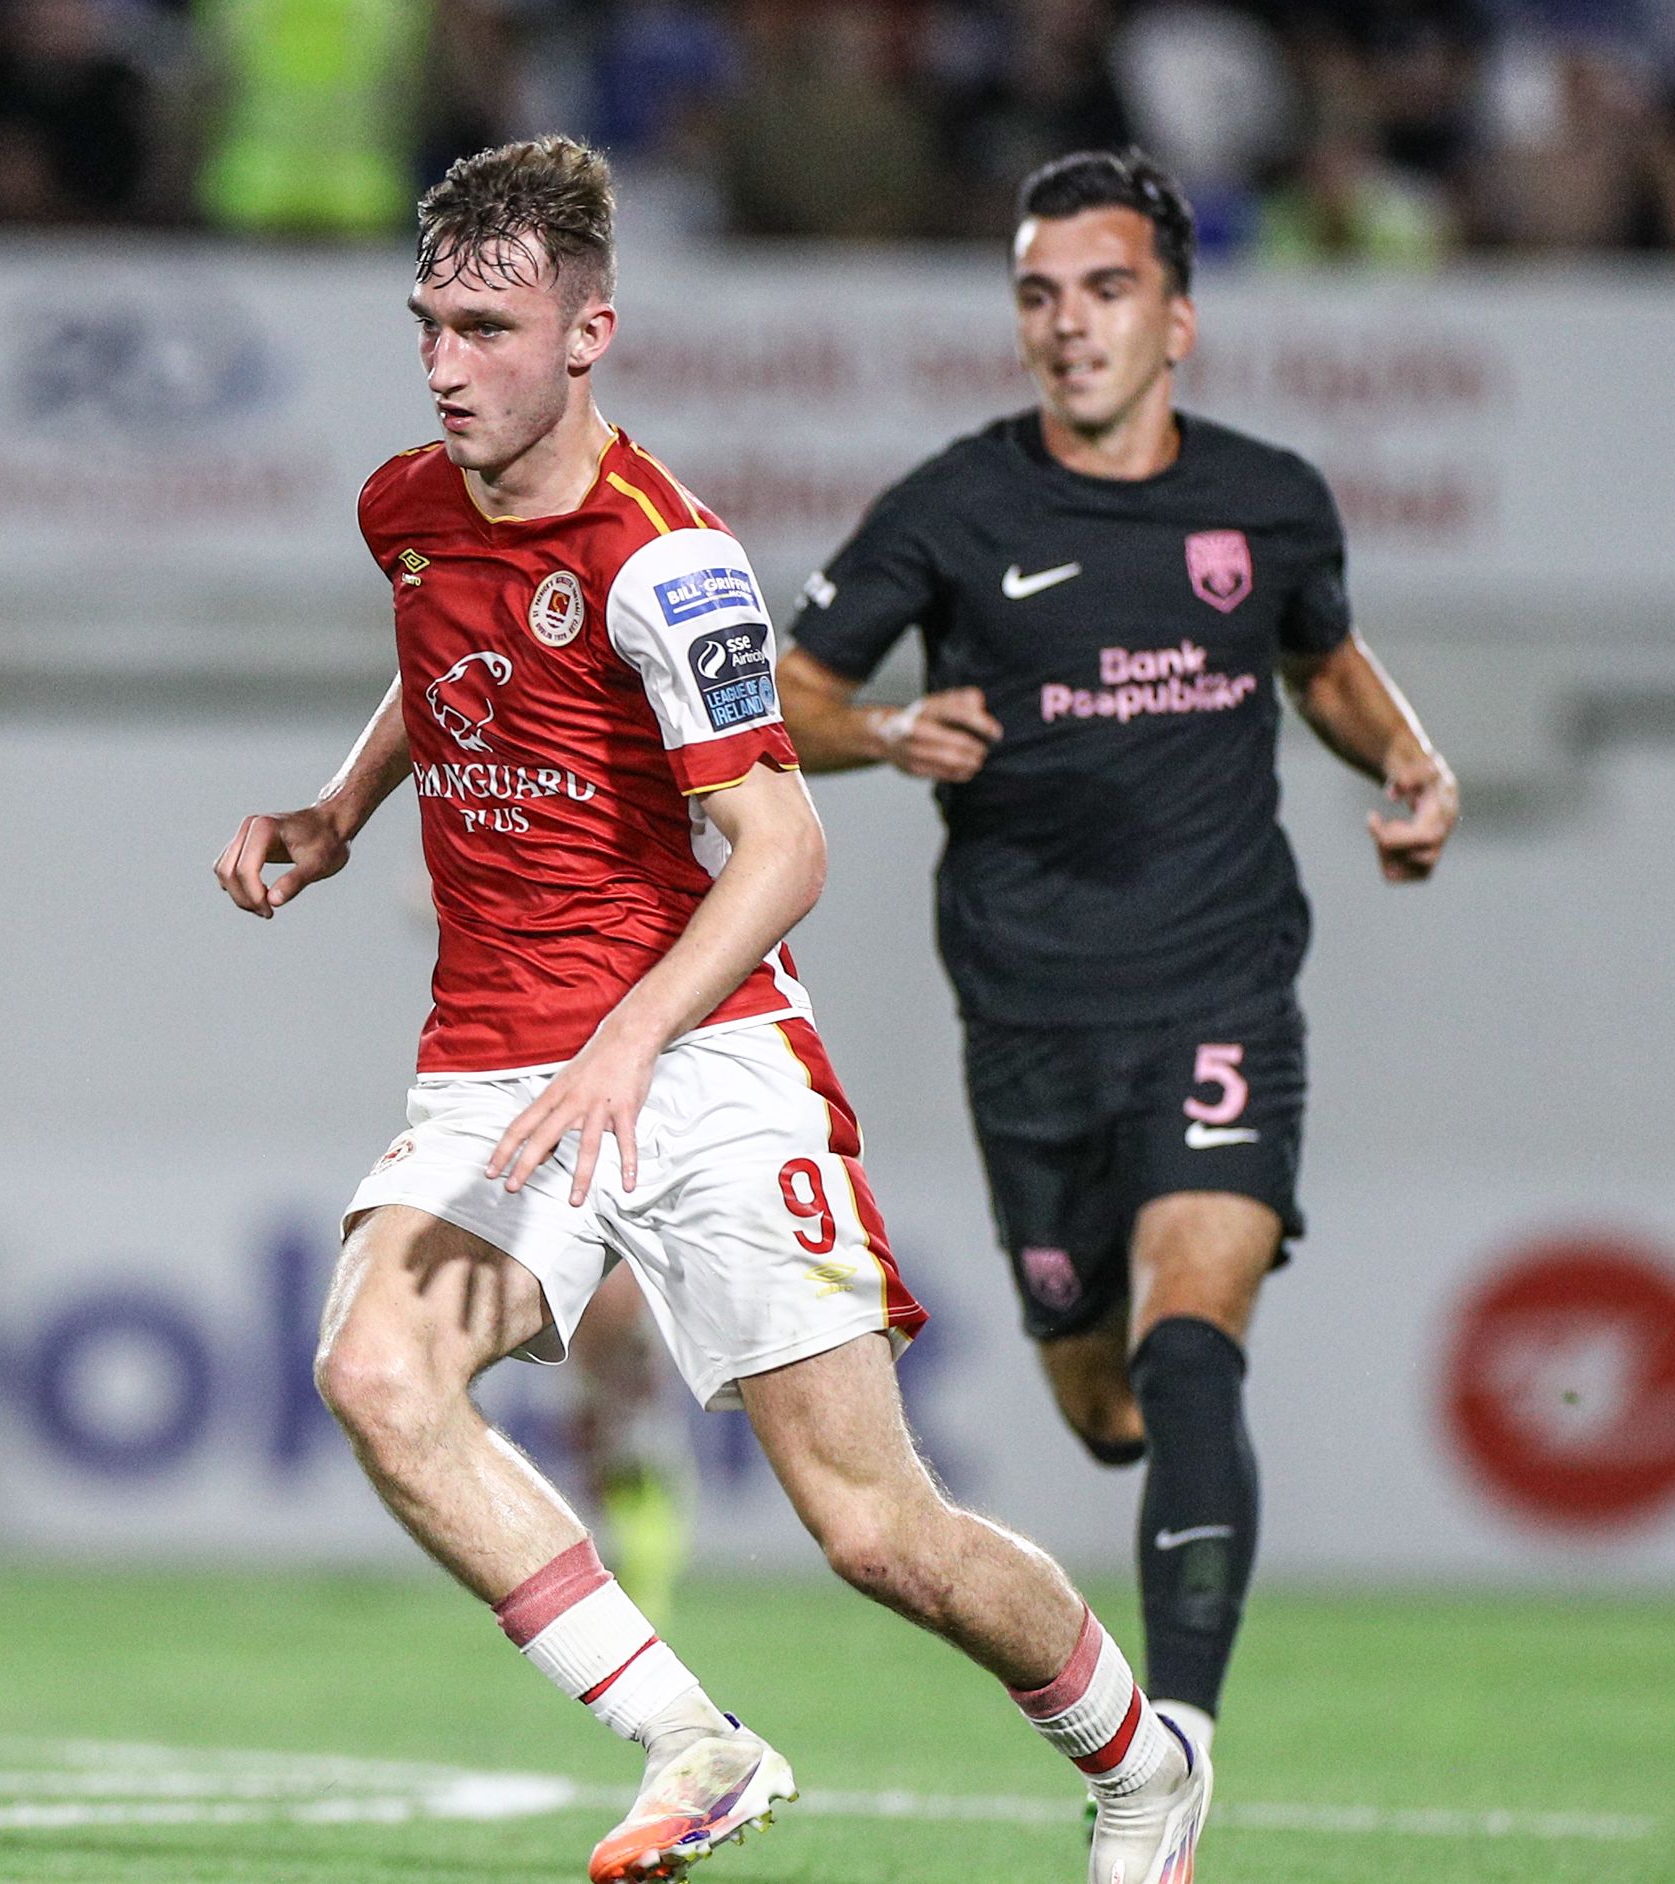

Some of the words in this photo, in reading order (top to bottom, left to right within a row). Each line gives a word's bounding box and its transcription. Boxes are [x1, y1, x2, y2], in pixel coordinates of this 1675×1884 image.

[666, 583, 702, 605] BILL
[726, 634, 752, 653] sse
[1099, 638, 1208, 686] Bank
[706, 682, 746, 709] LEAGUE
[746, 680, 758, 695] OF
[711, 695, 764, 727] IRELAND
[1183, 1043, 1250, 1126] 5
[778, 1157, 837, 1255] 9
